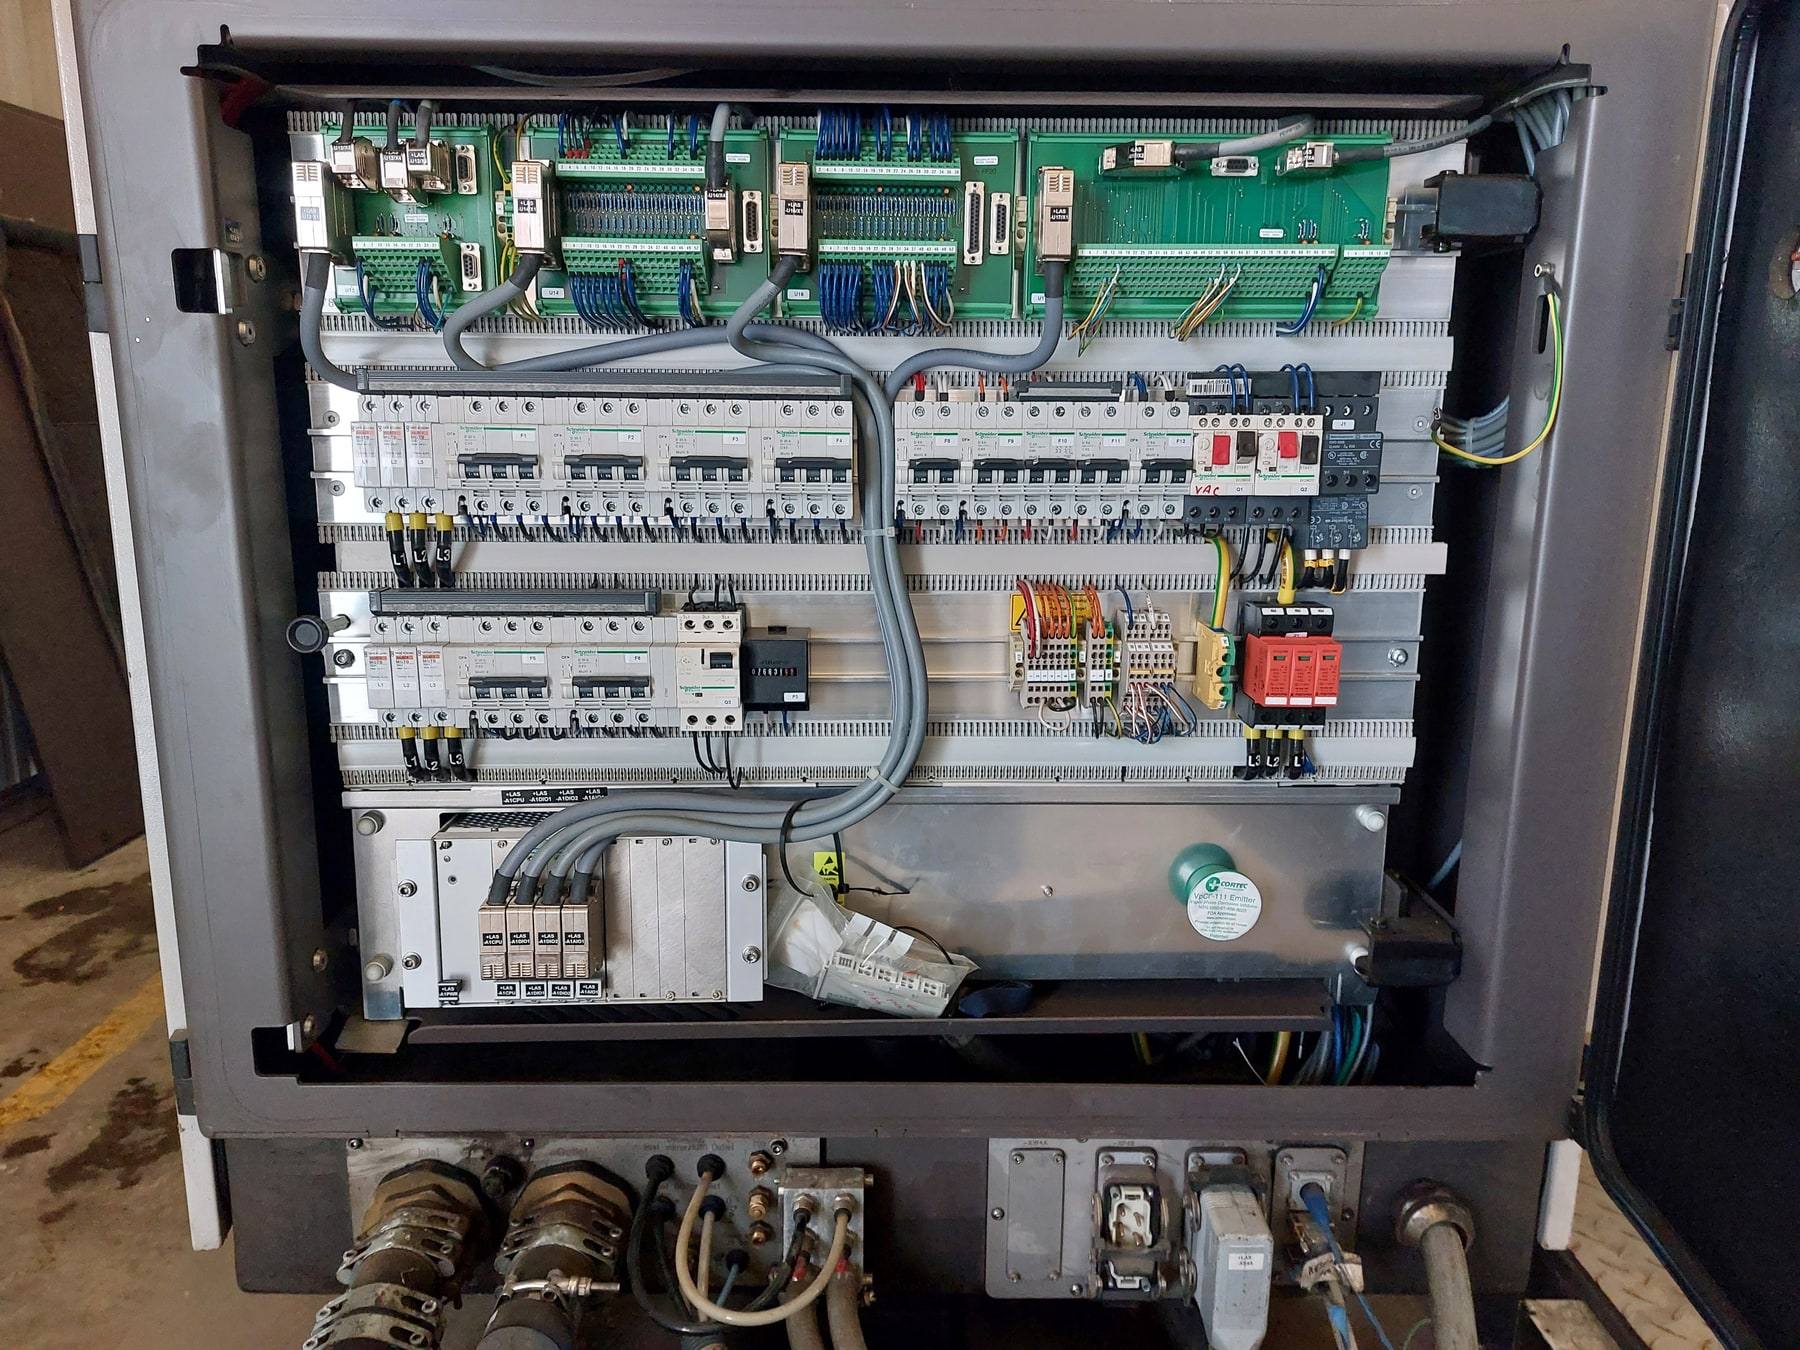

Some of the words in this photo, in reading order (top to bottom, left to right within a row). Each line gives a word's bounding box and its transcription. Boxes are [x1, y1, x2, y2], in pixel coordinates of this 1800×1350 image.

[1195, 485, 1219, 496] VAC
[392, 552, 406, 566] L1
[413, 550, 428, 563] L2
[436, 547, 451, 561] L3
[403, 754, 417, 768] L1
[425, 758, 438, 771] L2
[448, 753, 463, 766] L3
[1247, 755, 1261, 767] L3
[1266, 755, 1280, 768] L2
